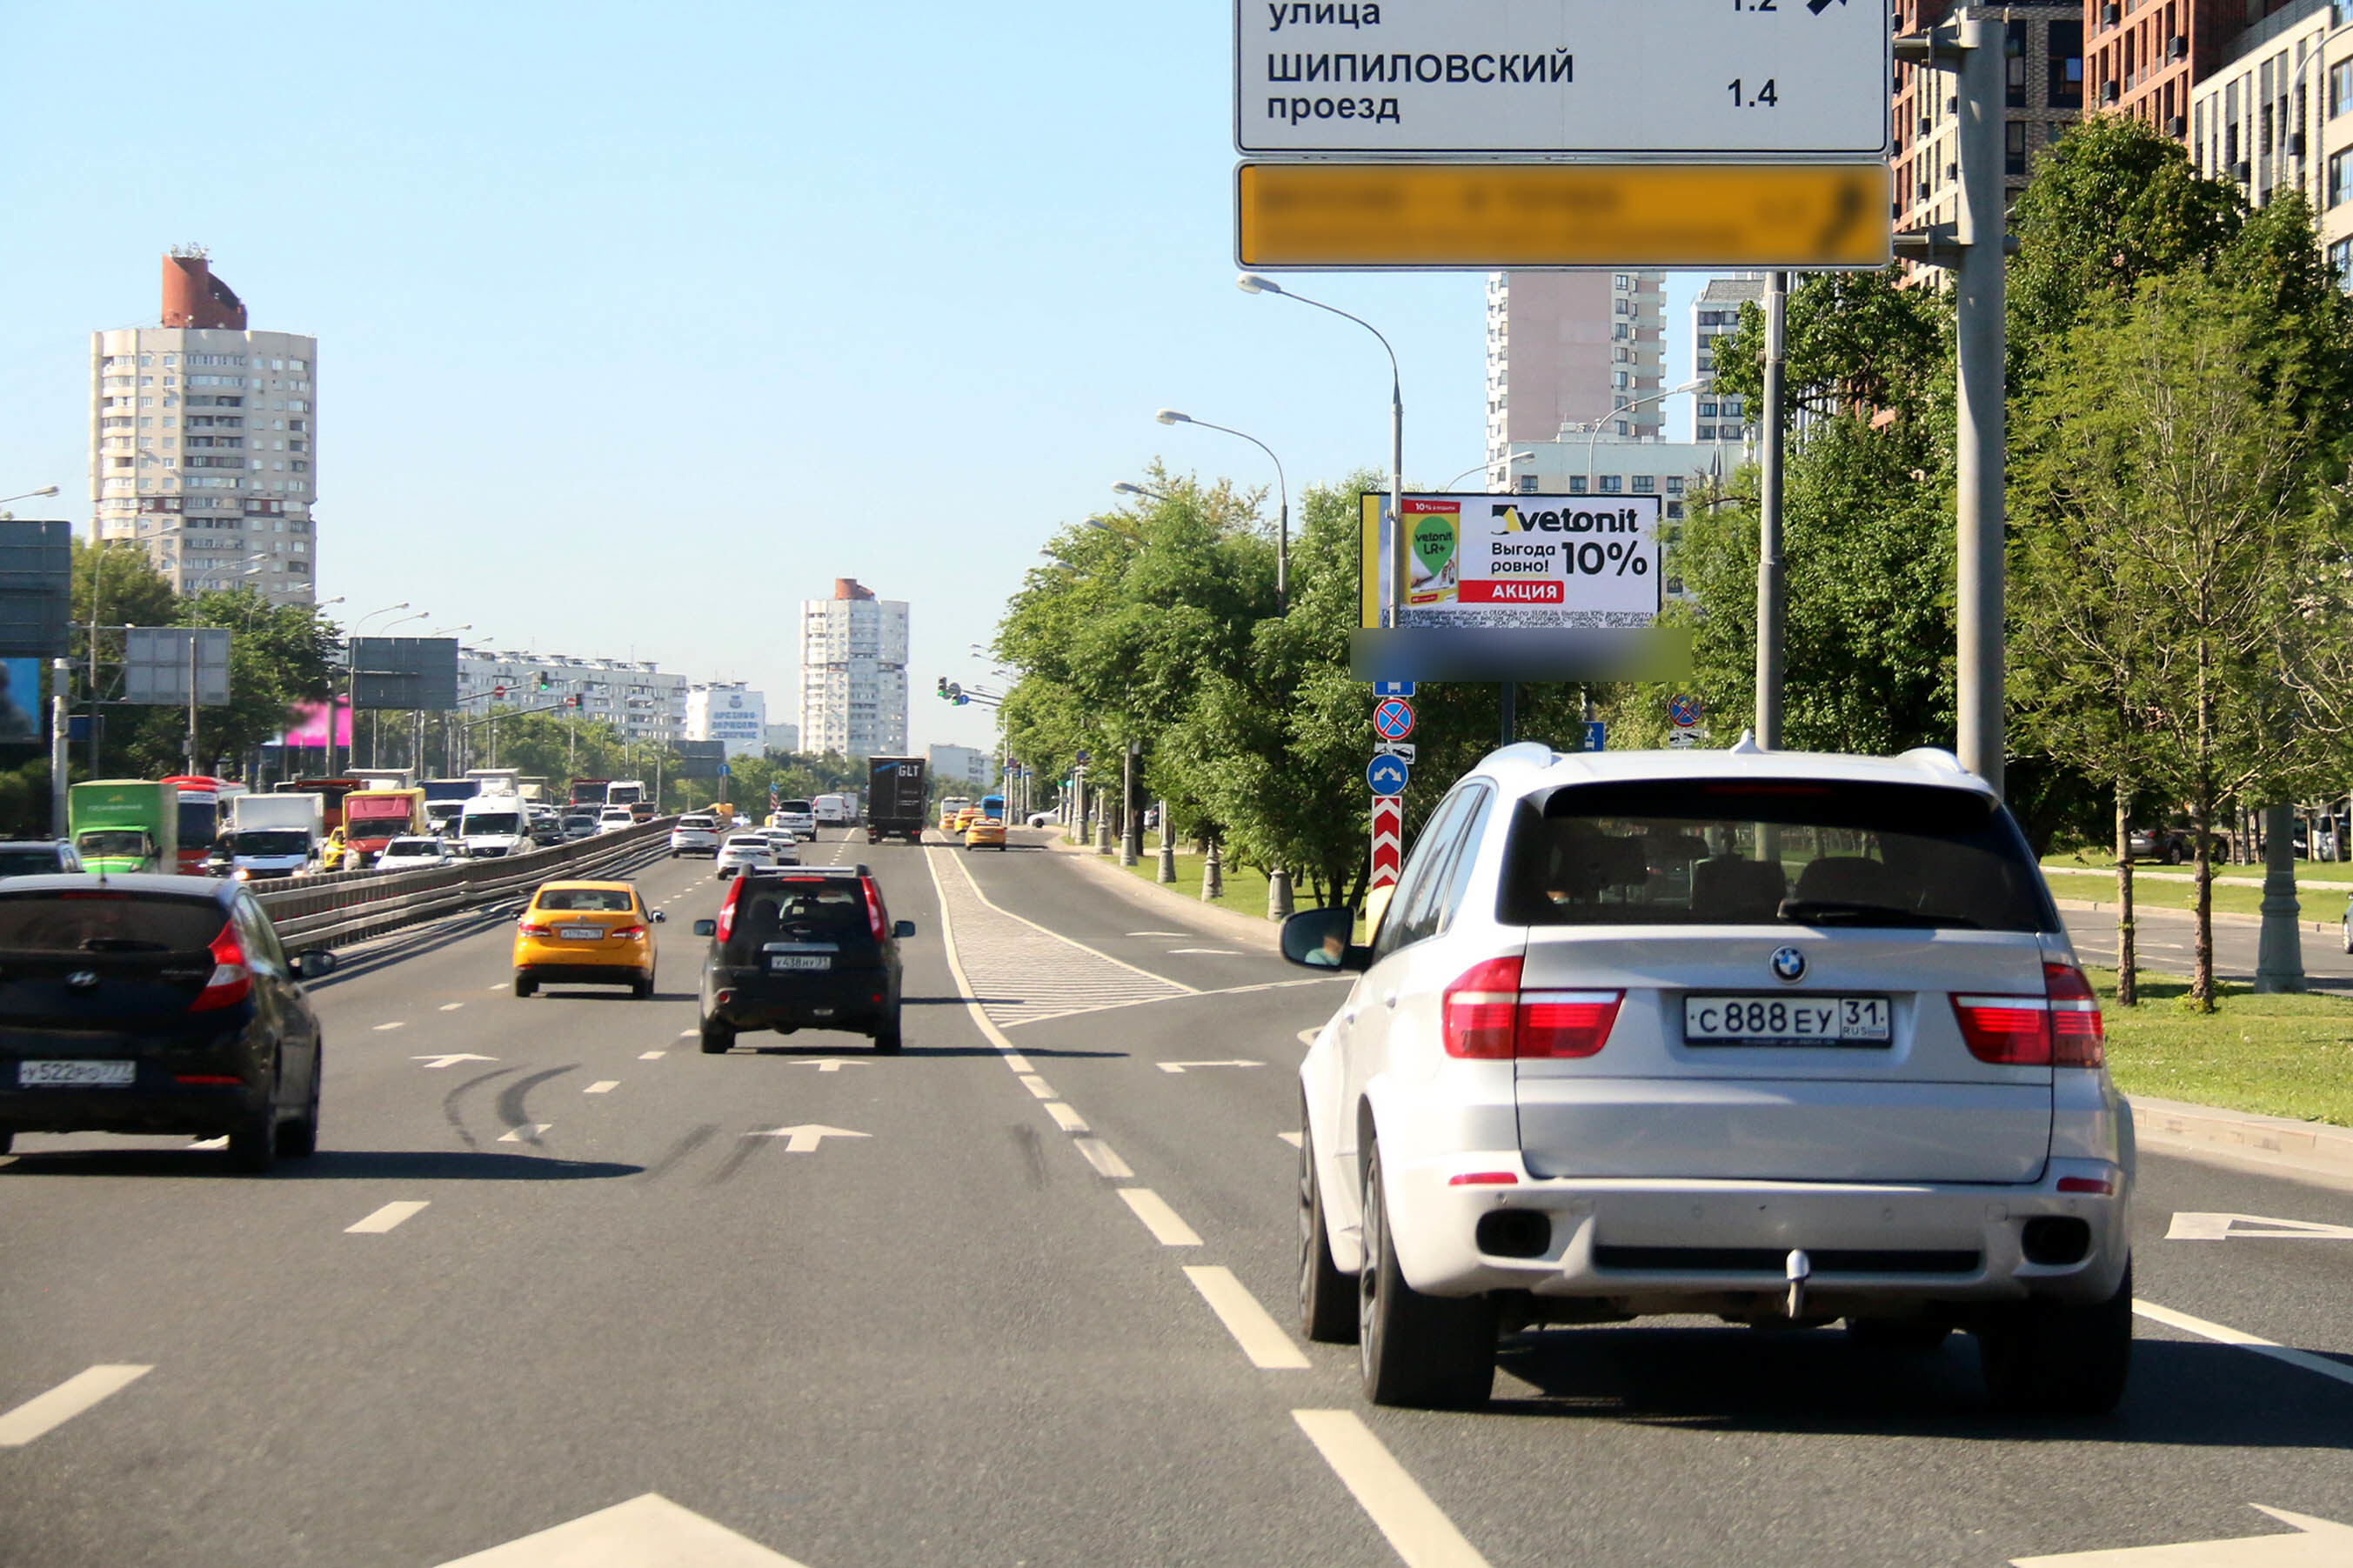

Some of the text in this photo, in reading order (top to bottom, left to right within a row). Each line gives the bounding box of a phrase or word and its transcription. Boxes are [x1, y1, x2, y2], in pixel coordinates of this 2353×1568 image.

[1268, 3, 1380, 32] улица
[1268, 48, 1574, 83] ШИПИЛОВСКИЙ
[1728, 78, 1778, 108] 1.4
[1267, 97, 1400, 125] проезд
[1521, 507, 1640, 533] vetonit
[1415, 531, 1453, 543] vetonit
[1423, 543, 1446, 555] LR+
[1492, 542, 1556, 558] Выгода
[1561, 540, 1648, 576] 10%
[1491, 560, 1549, 575] ровно!
[1492, 584, 1557, 600] АКЦИЯ
[898, 764, 919, 777] GLT
[1844, 1000, 1877, 1026] 31
[1843, 1026, 1868, 1036] RUS
